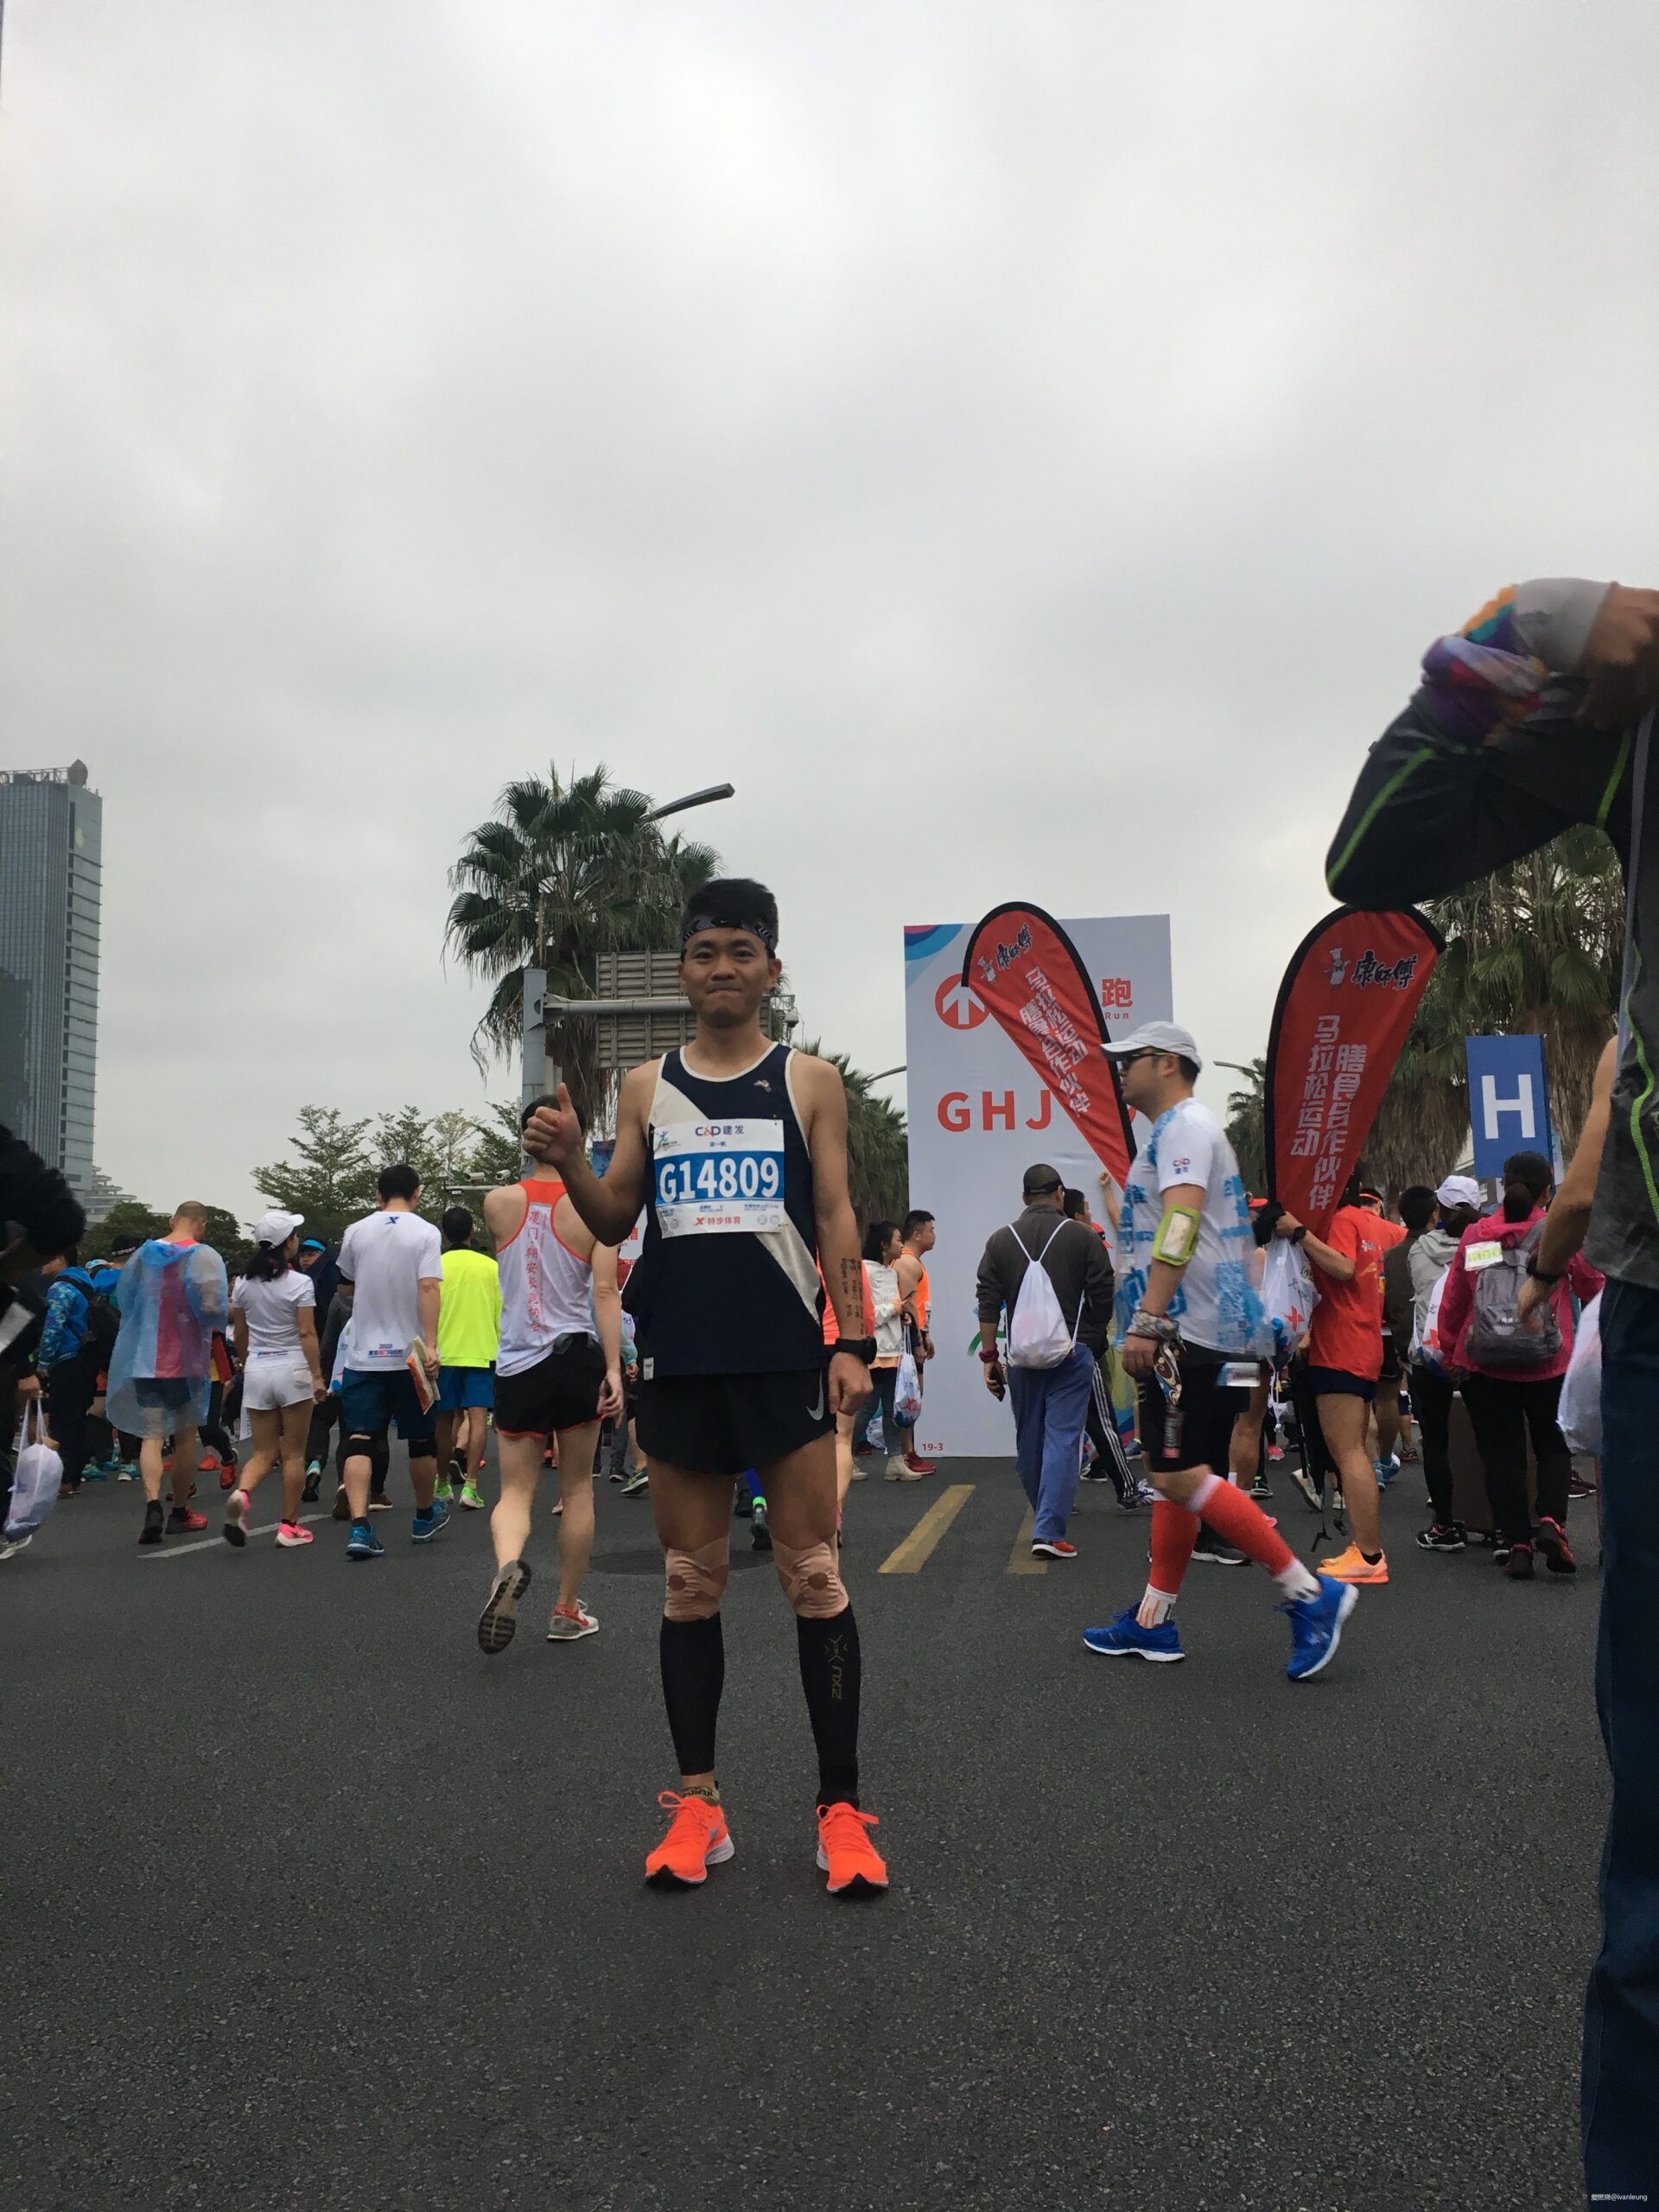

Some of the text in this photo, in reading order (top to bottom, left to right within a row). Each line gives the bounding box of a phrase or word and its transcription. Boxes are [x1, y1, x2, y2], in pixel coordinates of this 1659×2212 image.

[1290, 1014, 1340, 1156] 马拉松运动
[1481, 1074, 1535, 1139] H
[1309, 1044, 1368, 1210] 膳食合作伙伴
[660, 1158, 779, 1203] G14809
[922, 1443, 944, 1452] 19-3
